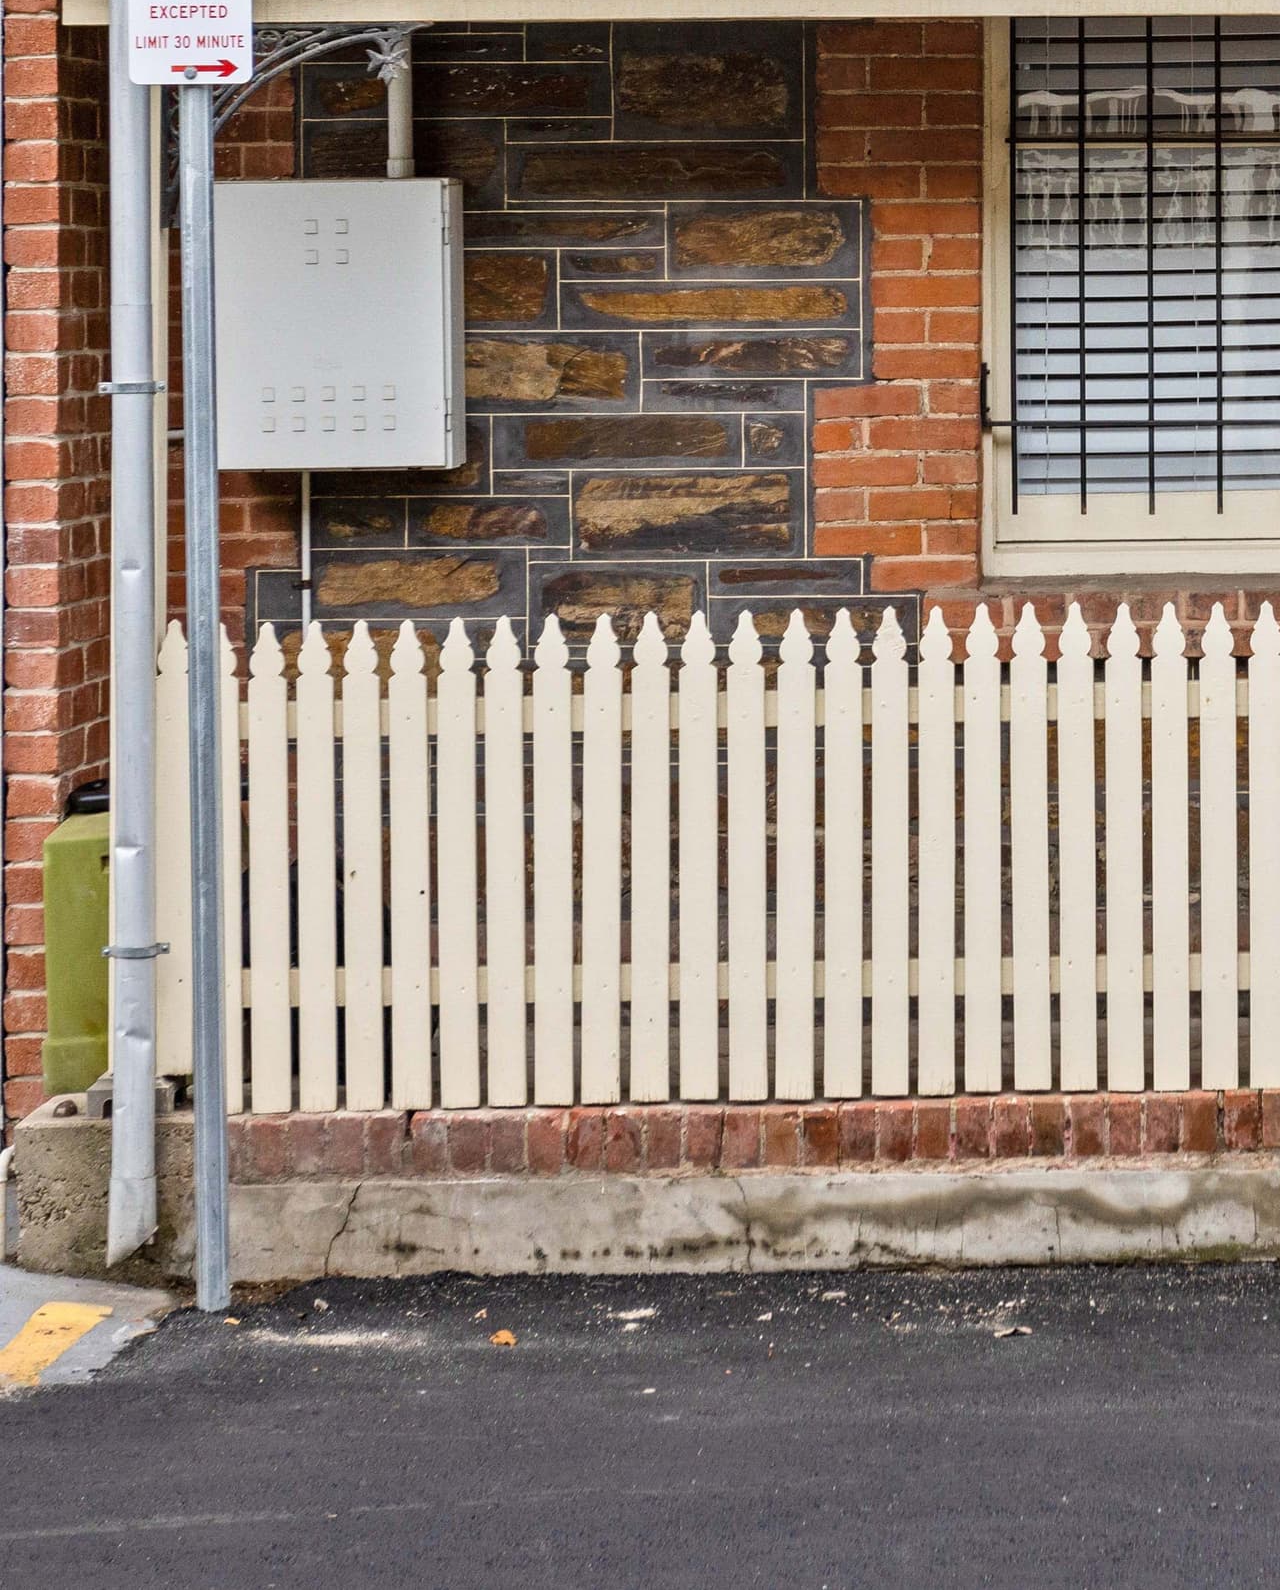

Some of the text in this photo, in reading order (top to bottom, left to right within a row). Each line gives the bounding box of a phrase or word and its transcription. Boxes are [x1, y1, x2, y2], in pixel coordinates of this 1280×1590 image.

[150, 5, 228, 18] EXCEPTED
[136, 35, 244, 49] LIMIT 30 MINUTE
